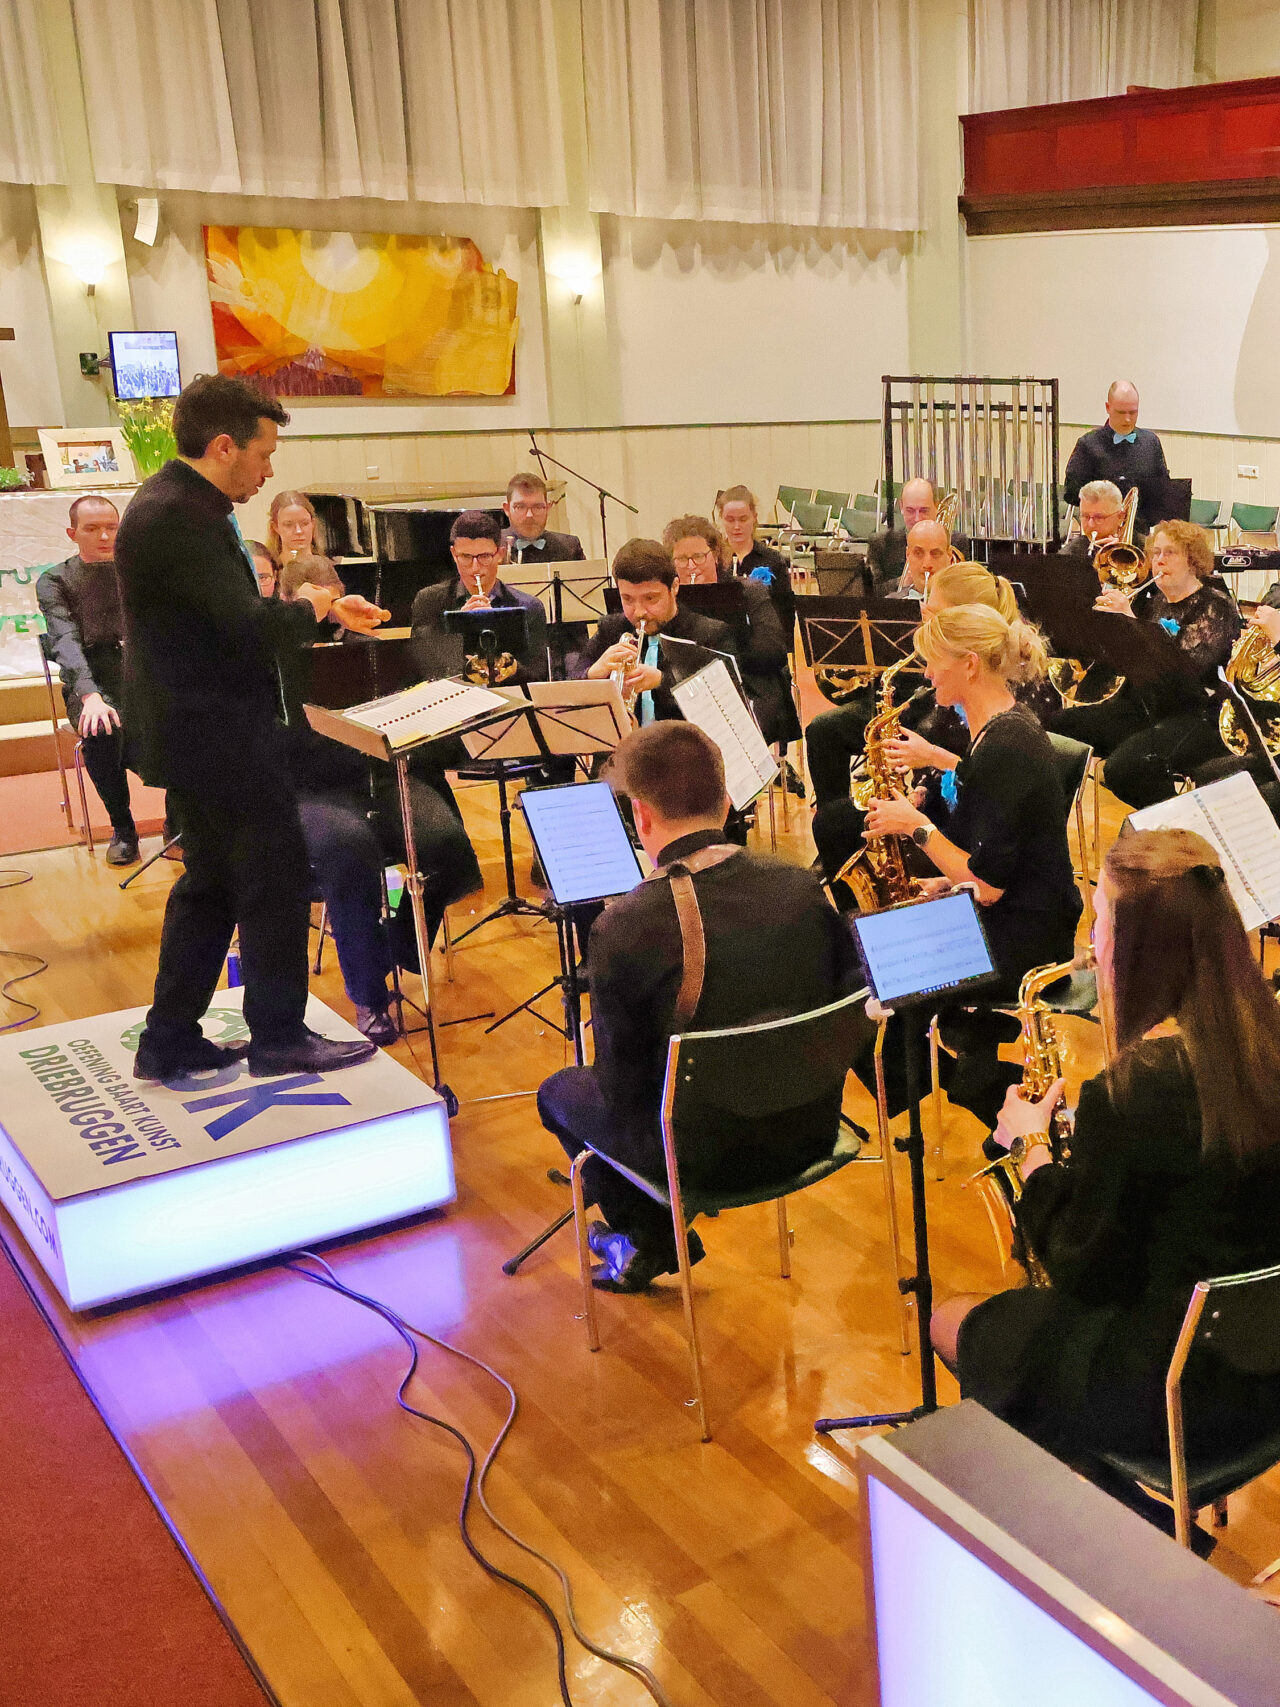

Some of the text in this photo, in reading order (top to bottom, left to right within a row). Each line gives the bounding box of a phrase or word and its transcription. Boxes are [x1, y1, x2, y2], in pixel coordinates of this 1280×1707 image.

[19, 1044, 147, 1166] DRIEBRUGGEN
[67, 1039, 182, 1151] OEFENING BAART KUNST
